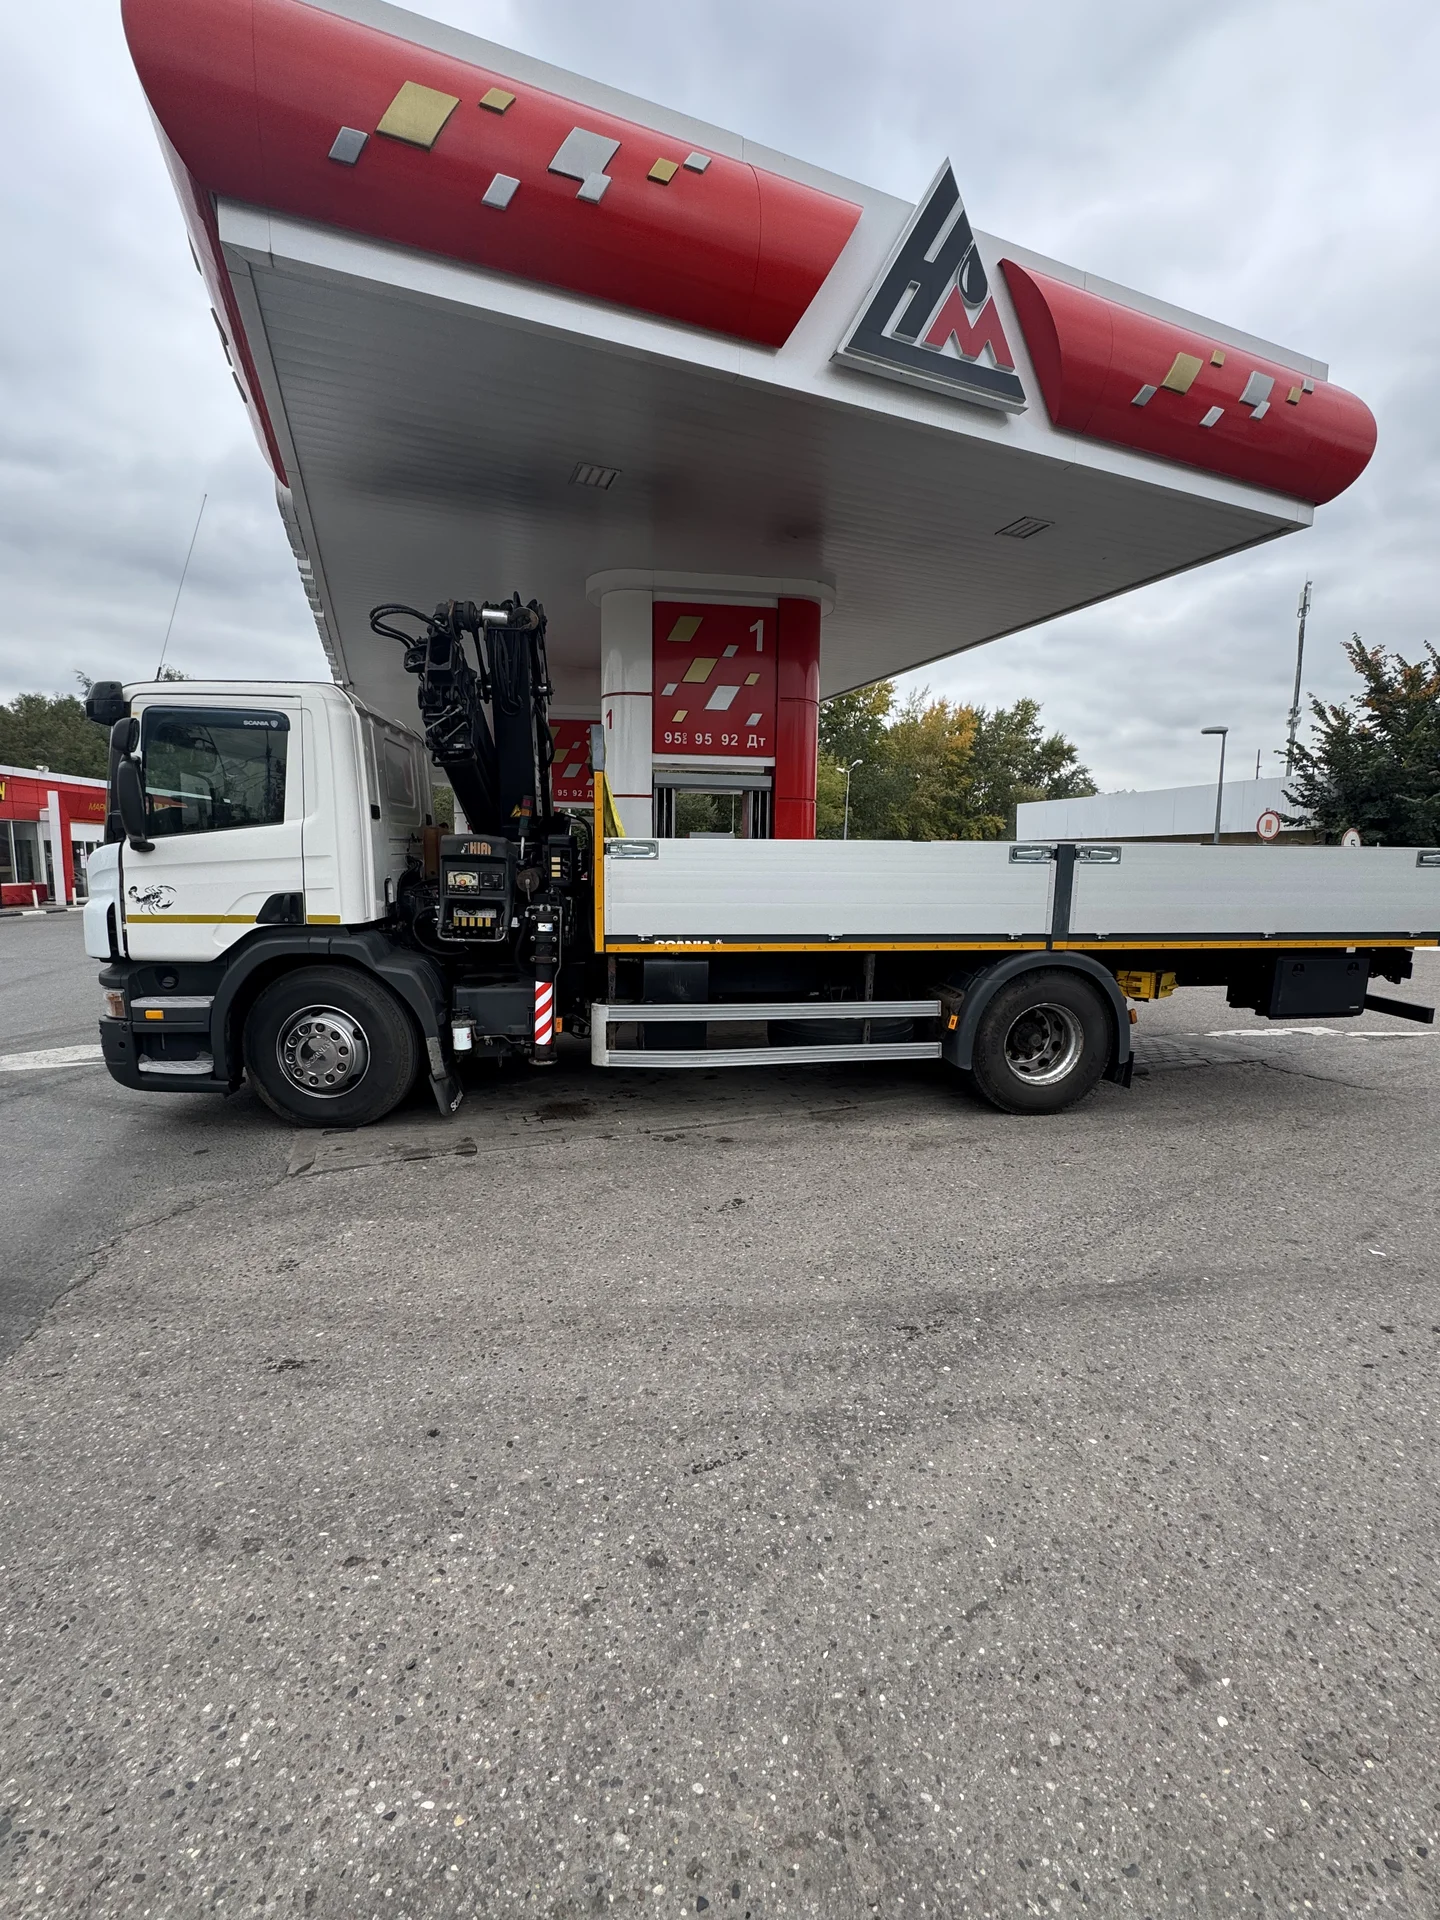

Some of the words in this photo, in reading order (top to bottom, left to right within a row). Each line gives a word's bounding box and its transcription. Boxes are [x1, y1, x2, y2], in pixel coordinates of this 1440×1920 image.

[750, 619, 764, 651] 1
[606, 709, 612, 729] 1
[695, 733, 712, 745] 95
[721, 733, 738, 746] 92
[747, 734, 766, 748] Дт
[557, 789, 568, 797] 95
[572, 789, 583, 797] 92
[587, 790, 594, 799] Д
